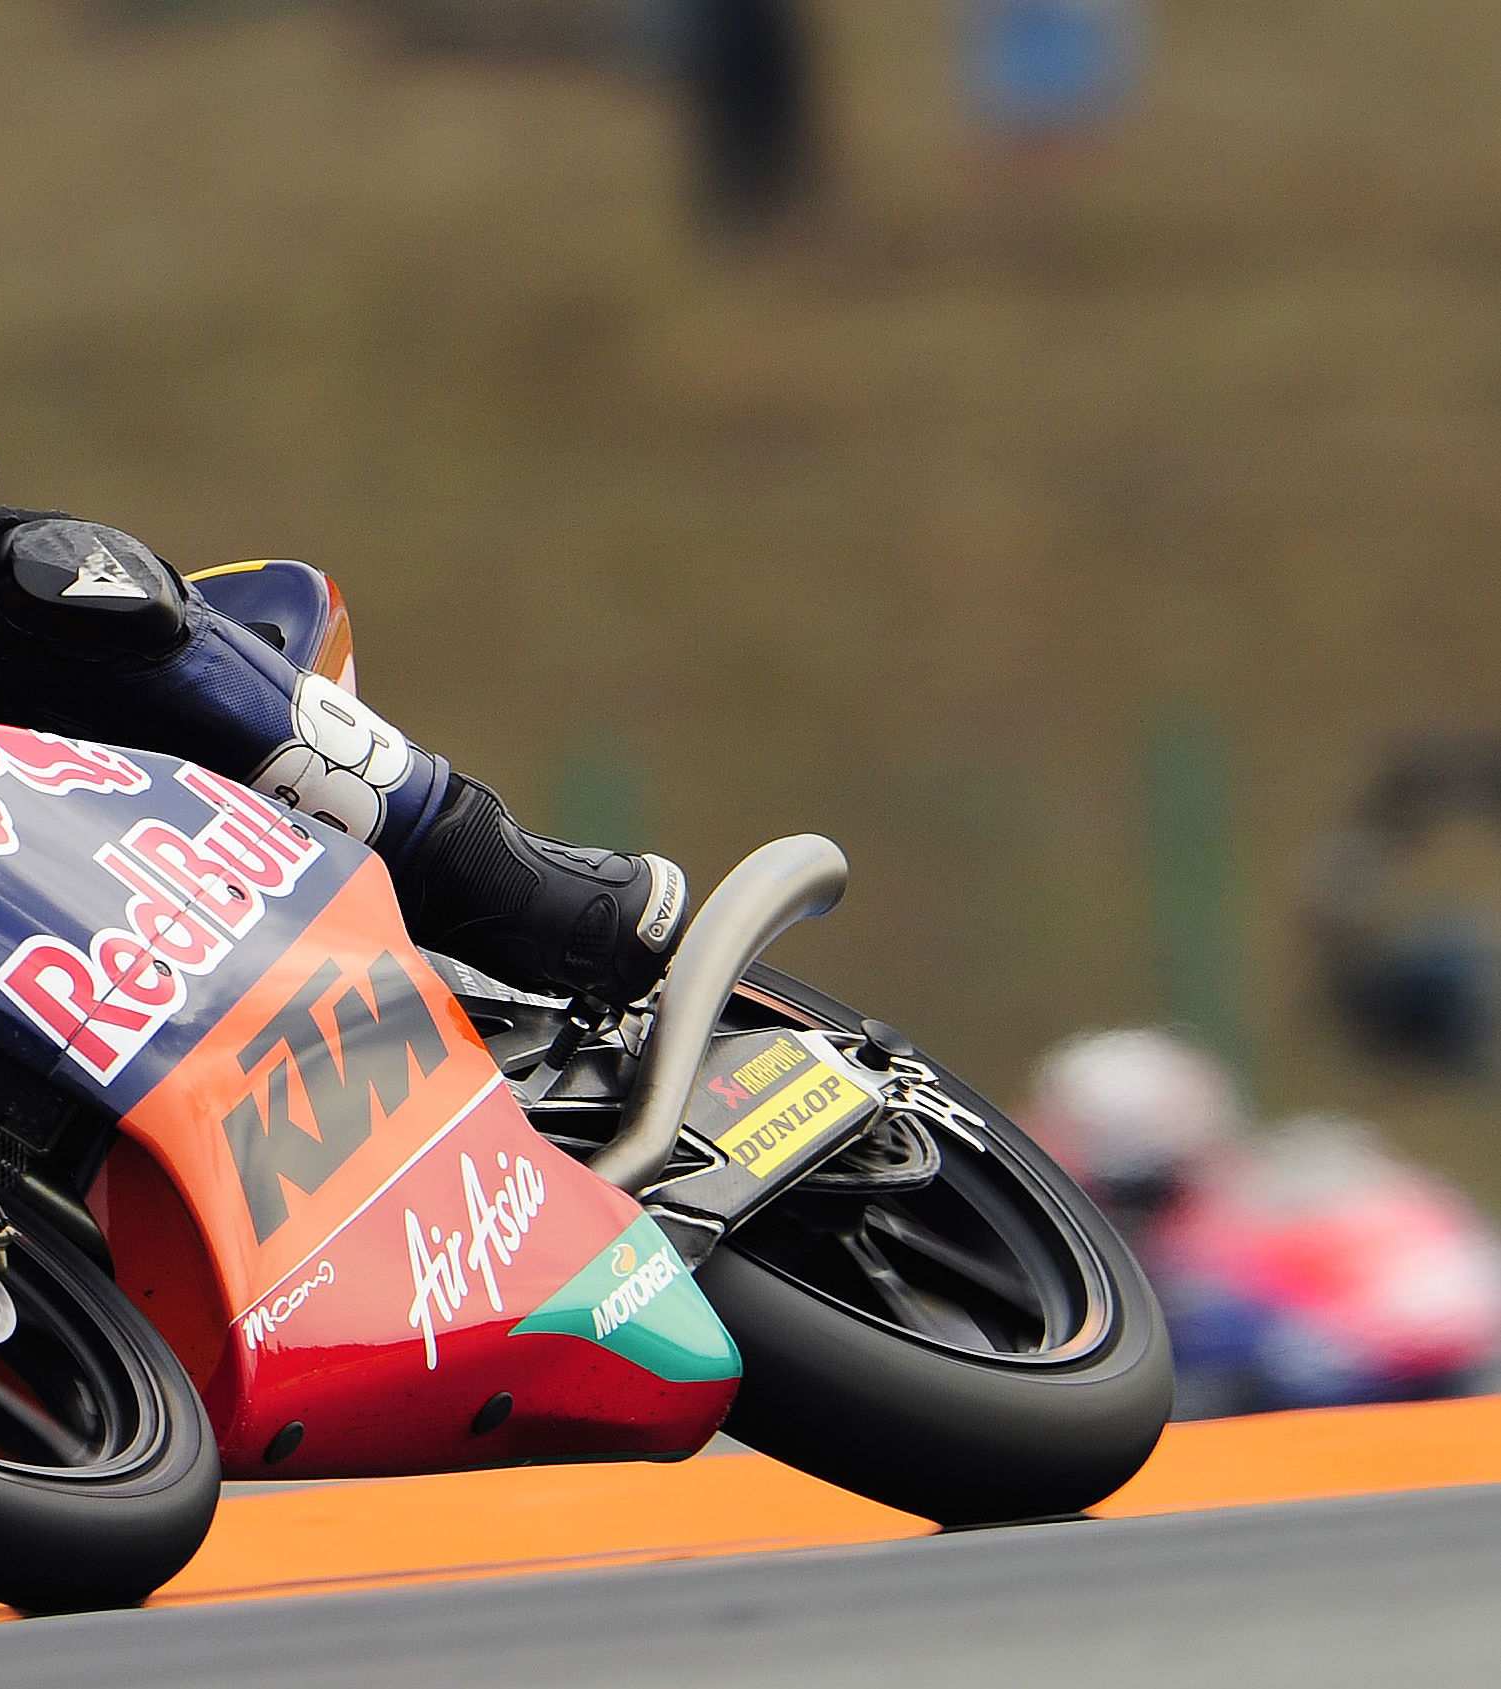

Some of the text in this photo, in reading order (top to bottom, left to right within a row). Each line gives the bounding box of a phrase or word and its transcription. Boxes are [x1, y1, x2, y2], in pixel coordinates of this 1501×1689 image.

[220, 948, 450, 1247] KTM
[731, 1074, 841, 1166] DUNLOP
[591, 1245, 680, 1340] MOTOREX
